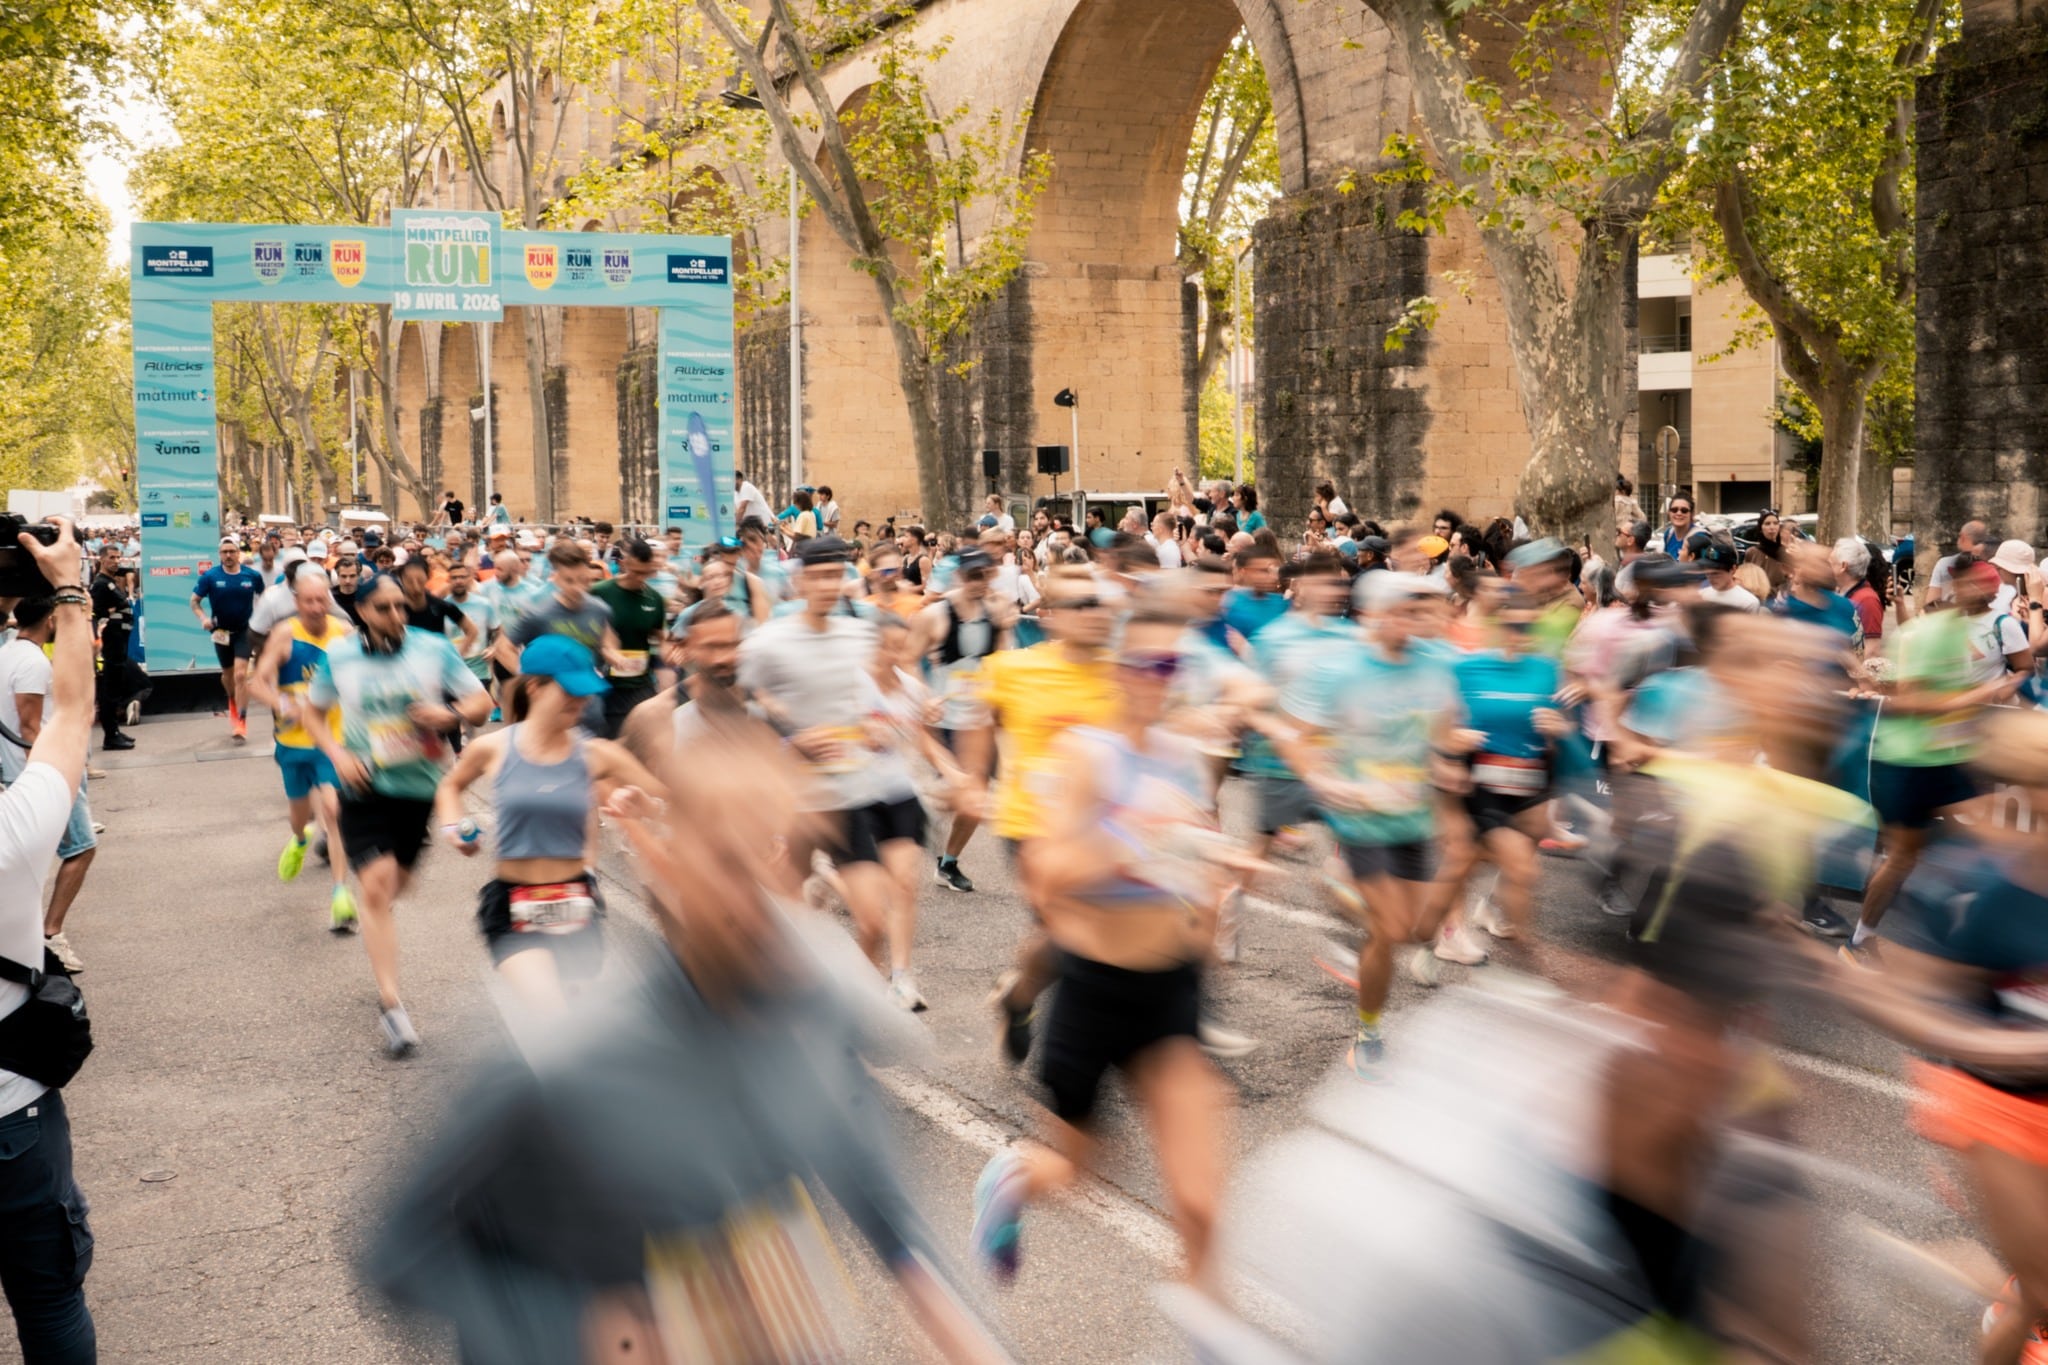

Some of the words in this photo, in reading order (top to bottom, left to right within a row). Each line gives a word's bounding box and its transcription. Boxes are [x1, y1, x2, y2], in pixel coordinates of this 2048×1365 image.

[407, 228, 489, 243] MONTPELLIER
[255, 247, 282, 261] RUN
[295, 248, 322, 261] RUN
[335, 249, 361, 262] RUN
[528, 253, 553, 266] RUN
[567, 254, 592, 267] RUN
[147, 259, 209, 267] MONTPELLIER
[407, 243, 490, 285] RUN
[604, 255, 629, 268] RUN
[671, 267, 724, 275] MONTPELLIER
[394, 292, 411, 310] 19
[415, 292, 459, 310] AVRIL
[463, 293, 501, 312] 2026
[144, 362, 204, 372] Alltricks
[674, 366, 726, 376] Alltricks
[137, 390, 198, 402] matmut
[668, 392, 719, 404] matmut
[155, 440, 201, 455] Runna
